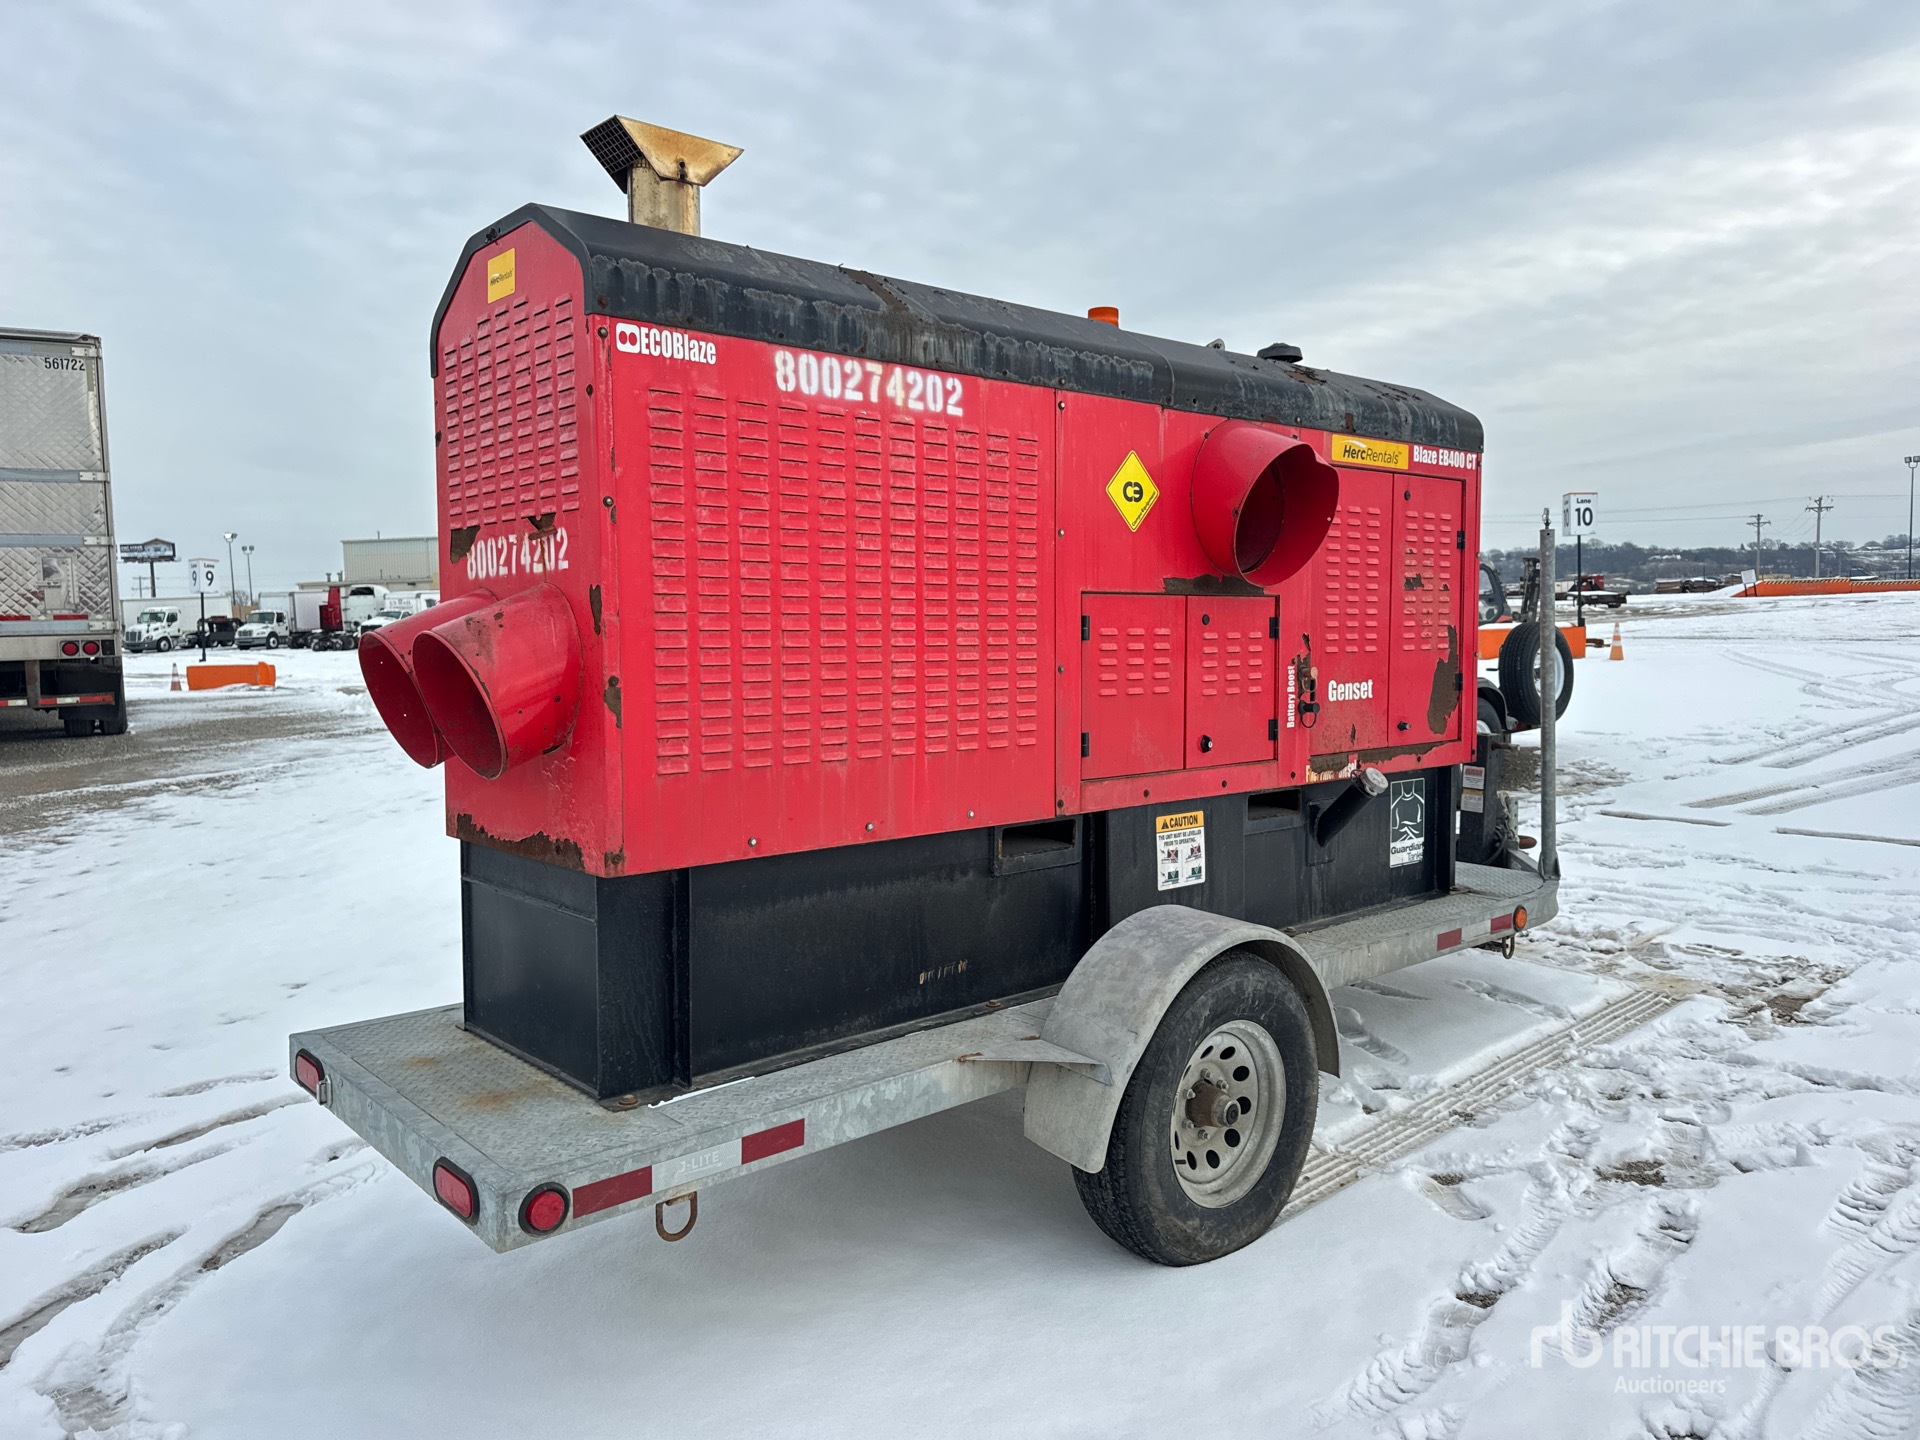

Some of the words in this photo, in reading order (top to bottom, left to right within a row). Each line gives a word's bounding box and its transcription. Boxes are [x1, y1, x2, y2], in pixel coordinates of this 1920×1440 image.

[640, 327, 716, 364] ECOBlaze
[44, 357, 86, 371] 561722
[774, 350, 964, 417] 800274202
[1413, 445, 1437, 465] Blaze
[1439, 449, 1465, 469] EB400
[1466, 453, 1478, 470] CT
[1575, 507, 1593, 526] 10
[467, 527, 568, 580] 800274202
[192, 571, 197, 587] 9
[205, 571, 214, 586] 9
[1287, 666, 1296, 692] Boost
[1328, 679, 1373, 702] Genset
[1287, 694, 1296, 729] Battery
[1169, 815, 1198, 828] CAUTION
